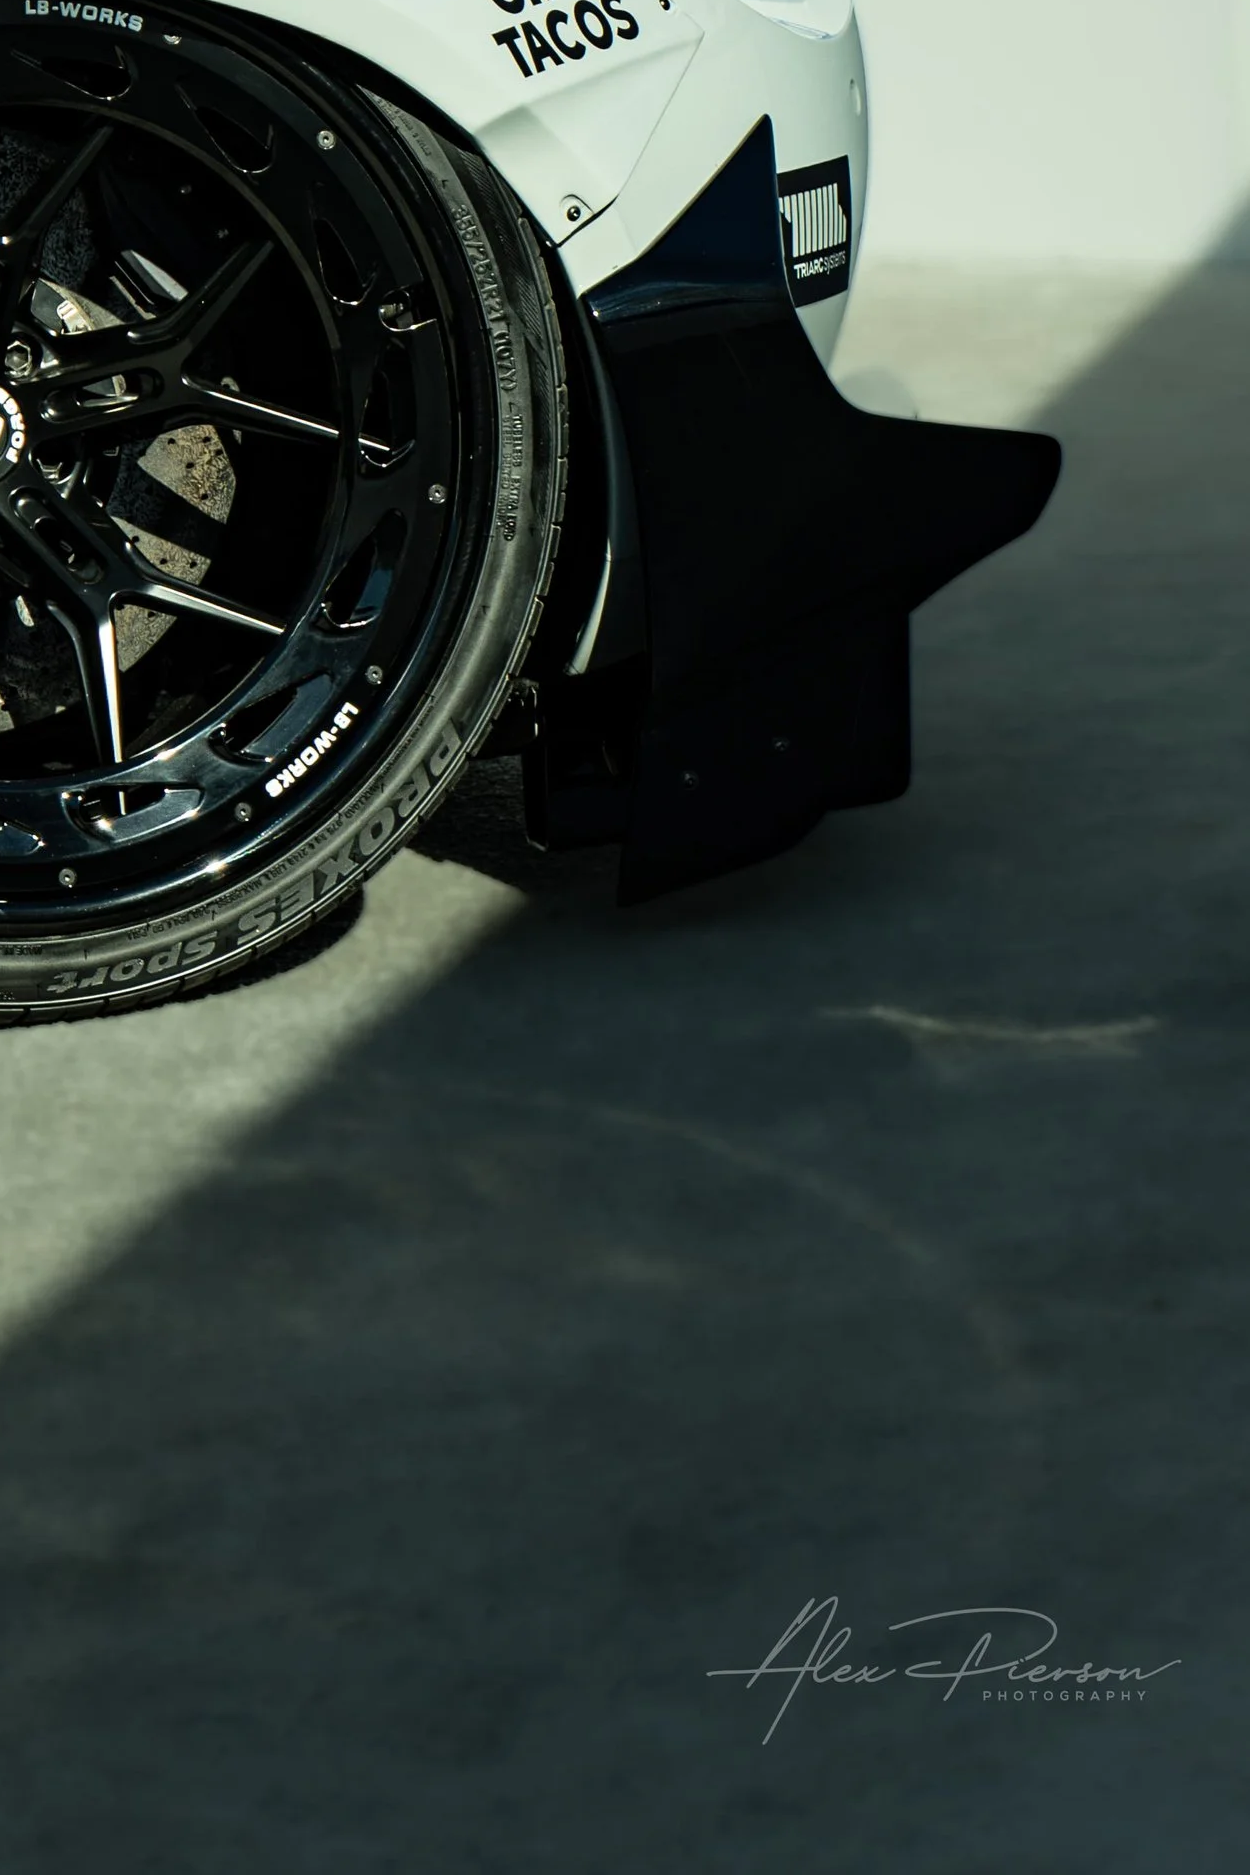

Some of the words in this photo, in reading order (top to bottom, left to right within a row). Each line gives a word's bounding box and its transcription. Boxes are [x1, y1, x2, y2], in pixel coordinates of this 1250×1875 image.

[25, 0, 144, 32] LB-WORKS
[265, 701, 359, 798] LB-WORKS
[226, 717, 470, 944] PROXES
